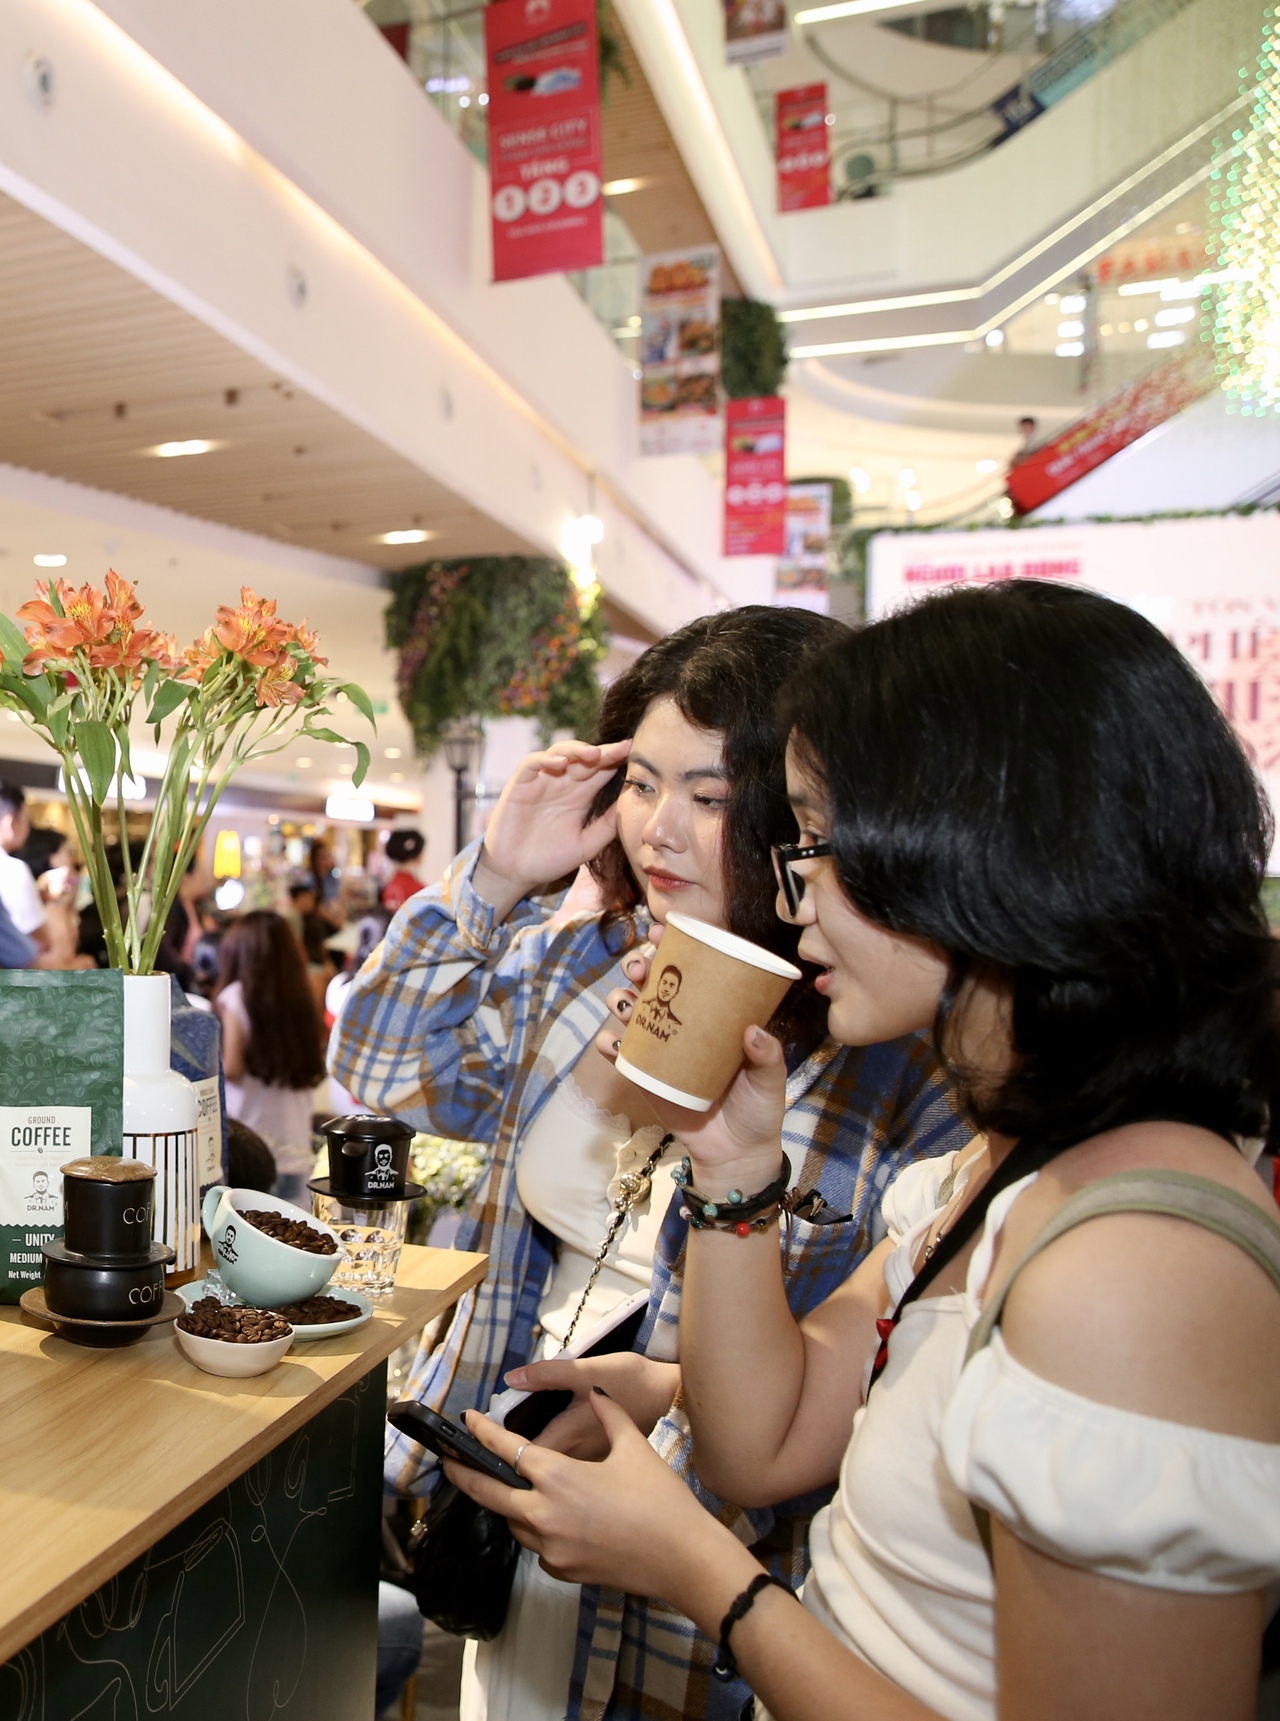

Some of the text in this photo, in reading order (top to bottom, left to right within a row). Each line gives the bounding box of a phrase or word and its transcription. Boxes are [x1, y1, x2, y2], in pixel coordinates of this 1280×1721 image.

[635, 1013, 671, 1043] DR.NAM
[28, 1115, 56, 1125] GROUND
[11, 1126, 72, 1147] COFFEE
[367, 1181, 395, 1189] DR.NAM
[26, 1204, 55, 1212] DR.NAM
[25, 1233, 55, 1247] UNITY
[10, 1252, 43, 1264] MEDIUM
[8, 1270, 41, 1280] Net Weight
